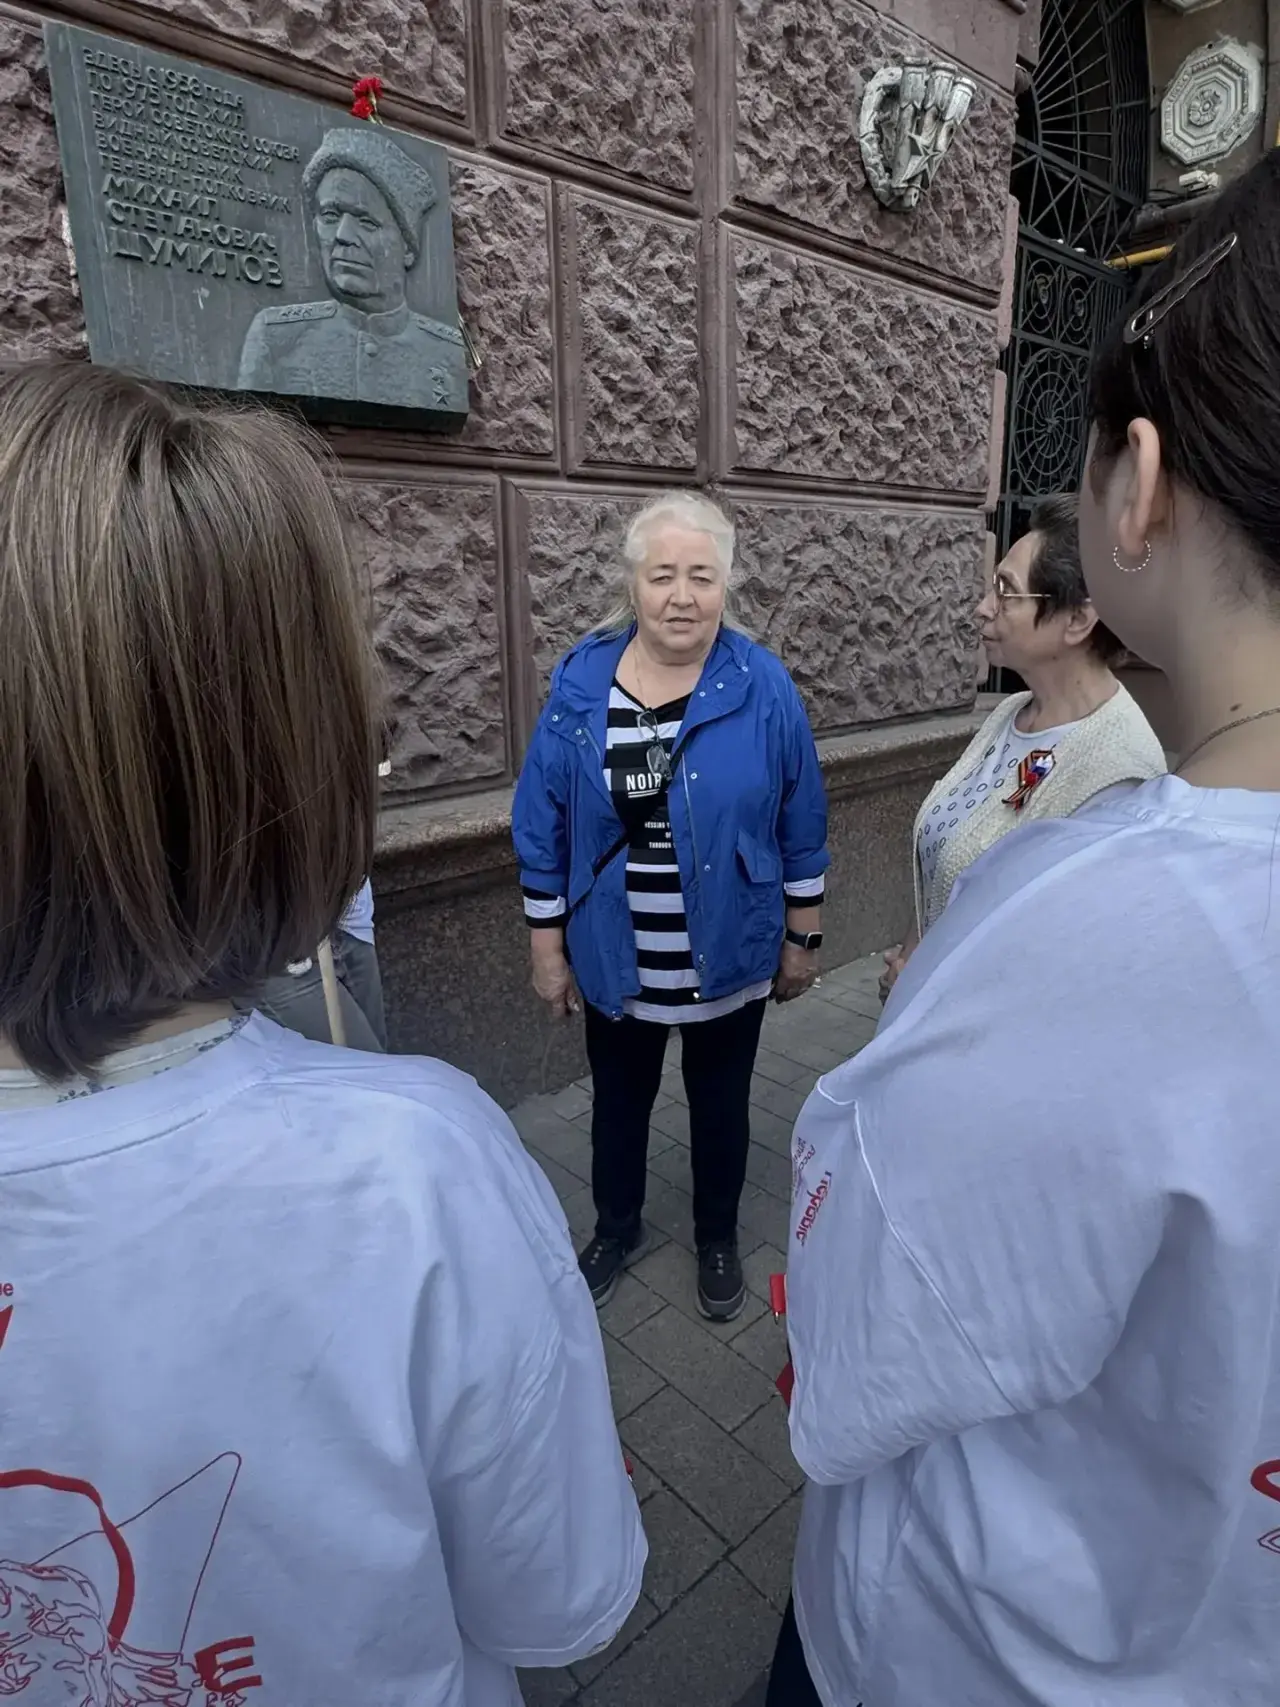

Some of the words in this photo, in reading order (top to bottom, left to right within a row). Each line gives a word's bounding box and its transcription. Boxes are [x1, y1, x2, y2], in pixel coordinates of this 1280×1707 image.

[102, 174, 220, 221] МИХАИЛ
[104, 198, 279, 257] СТЕПАНОВИЧ
[109, 226, 284, 286] ШУМИЛОВ
[626, 773, 662, 791] NOIR
